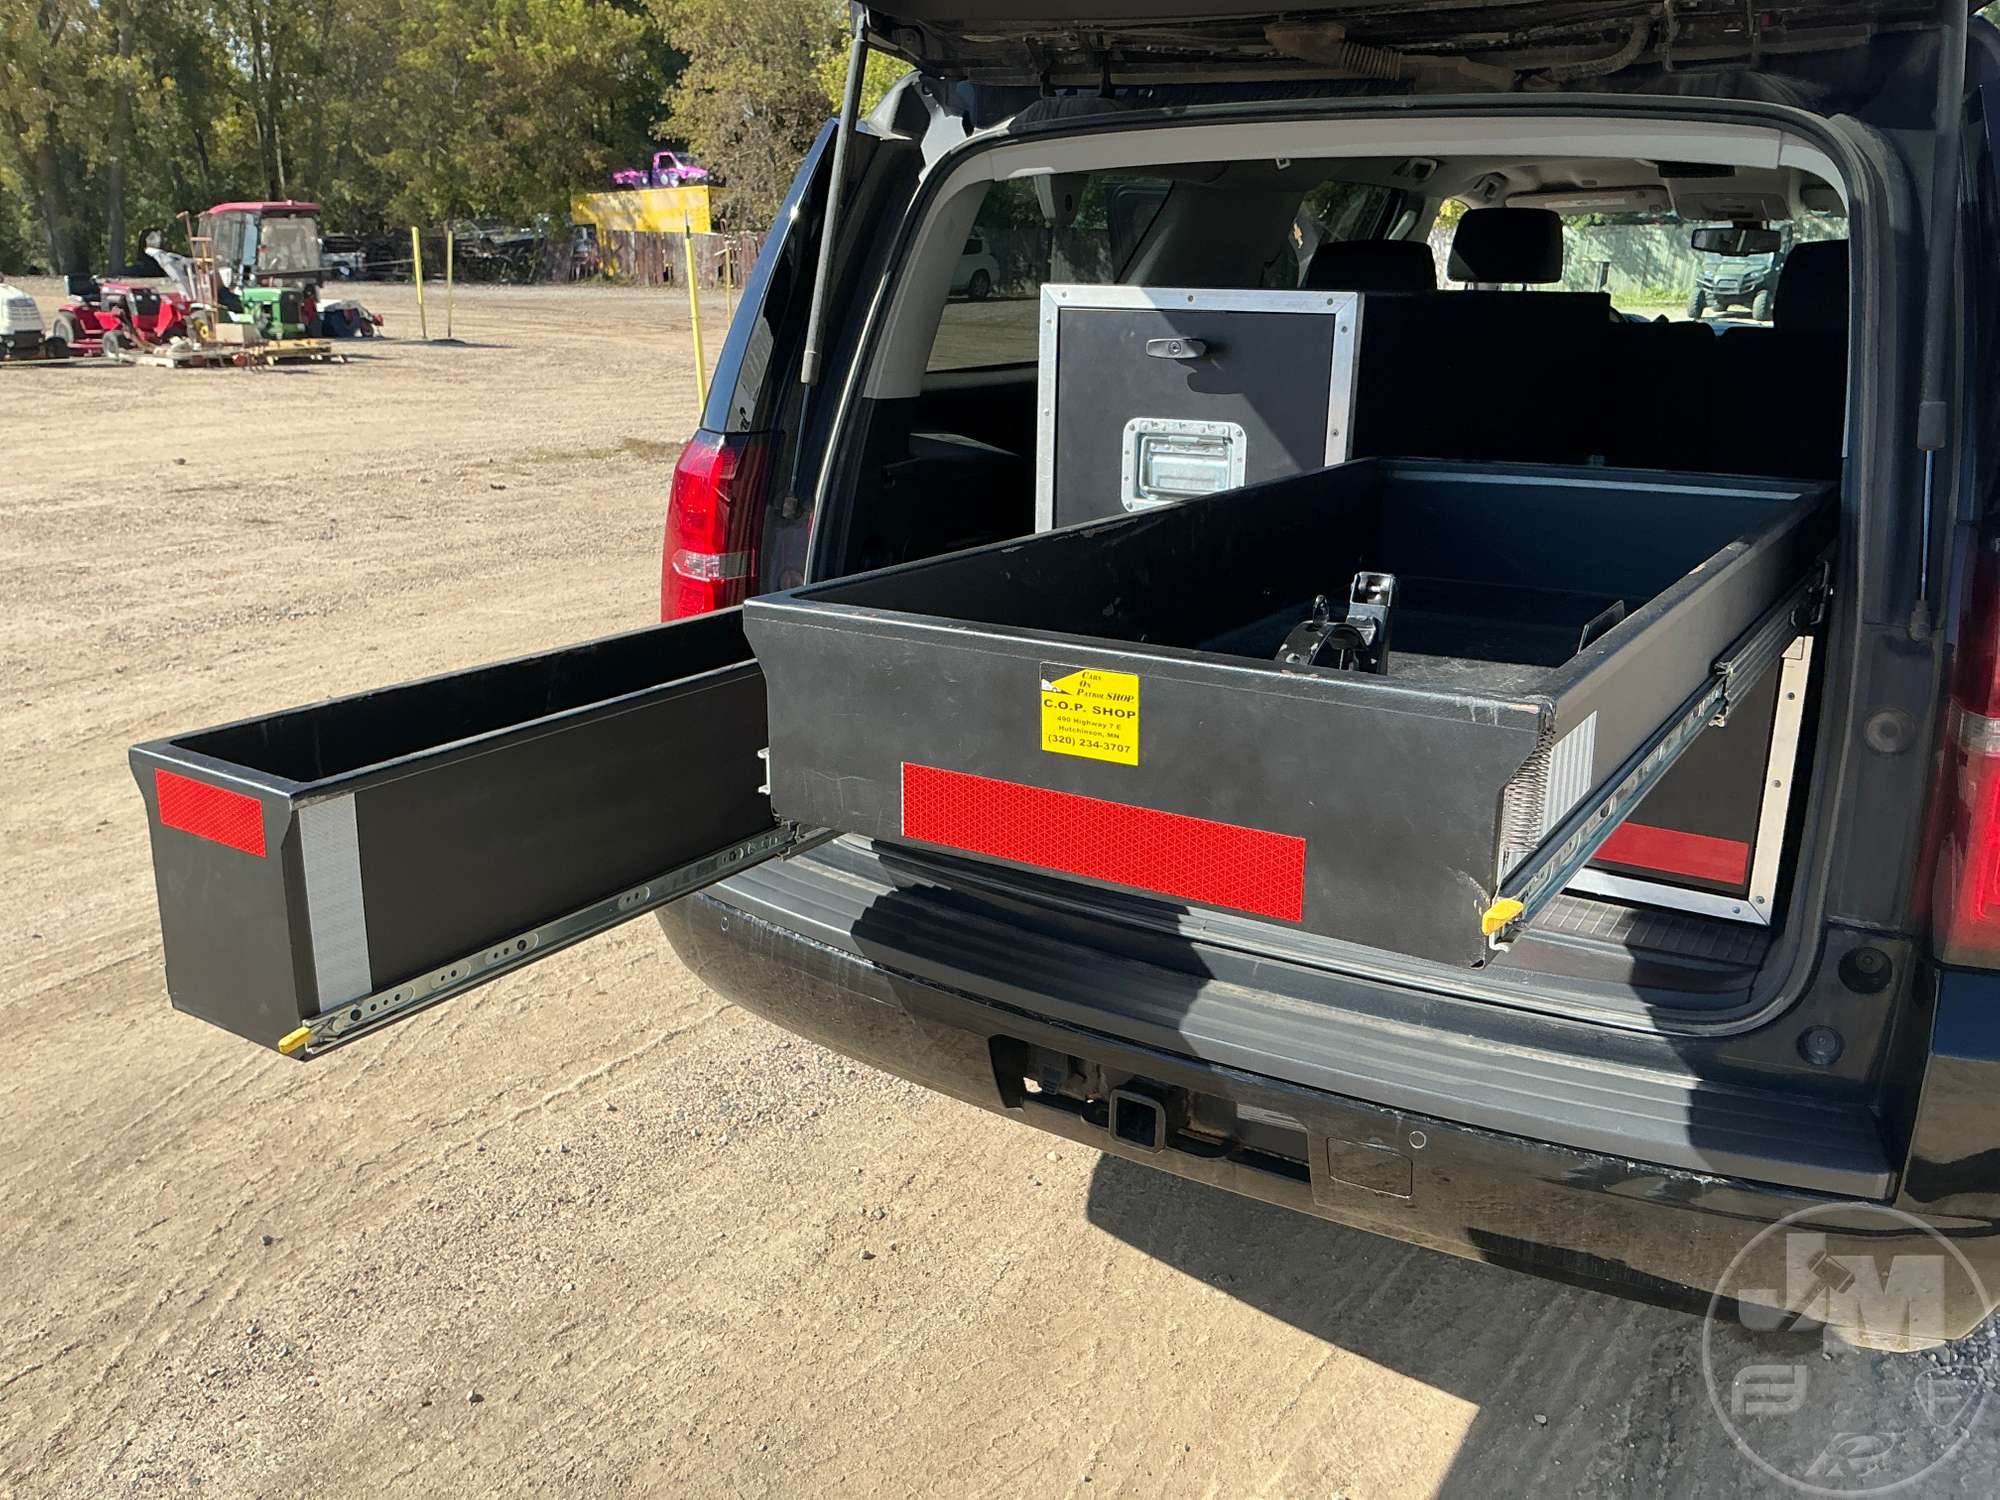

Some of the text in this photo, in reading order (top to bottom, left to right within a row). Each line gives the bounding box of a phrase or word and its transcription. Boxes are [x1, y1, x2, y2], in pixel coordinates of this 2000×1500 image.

[1106, 692, 1134, 702] SHOP
[1044, 699, 1136, 719] C.O.P. SHOP
[1048, 734, 1131, 753] (320) 234-3707
